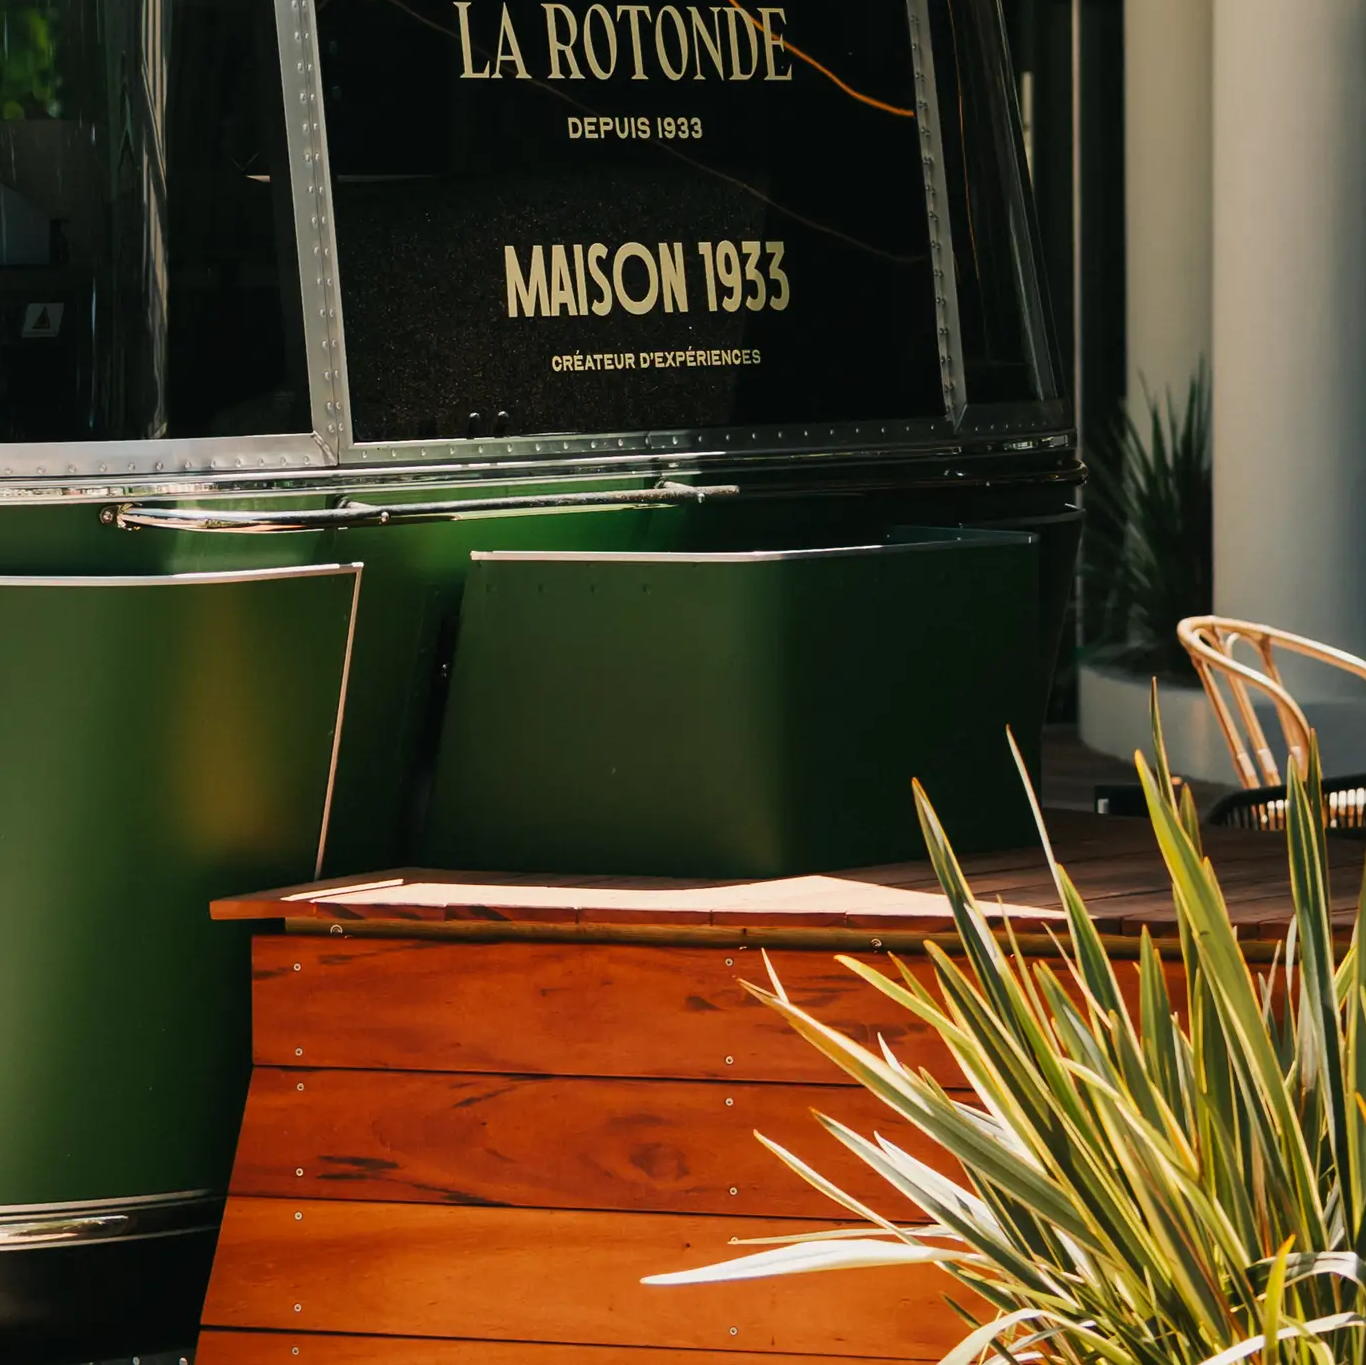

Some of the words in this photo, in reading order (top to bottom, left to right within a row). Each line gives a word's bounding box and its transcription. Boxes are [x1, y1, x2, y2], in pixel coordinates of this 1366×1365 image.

[452, 1, 532, 80] LA
[540, 3, 793, 81] ROTONDE
[567, 117, 651, 140] DEPUIS
[657, 116, 703, 139] 1933
[504, 241, 689, 318] MAISON
[697, 239, 790, 313] 1933
[551, 349, 636, 372] CRÉATEUR
[639, 346, 761, 369] D'EXPÉRIENCES
